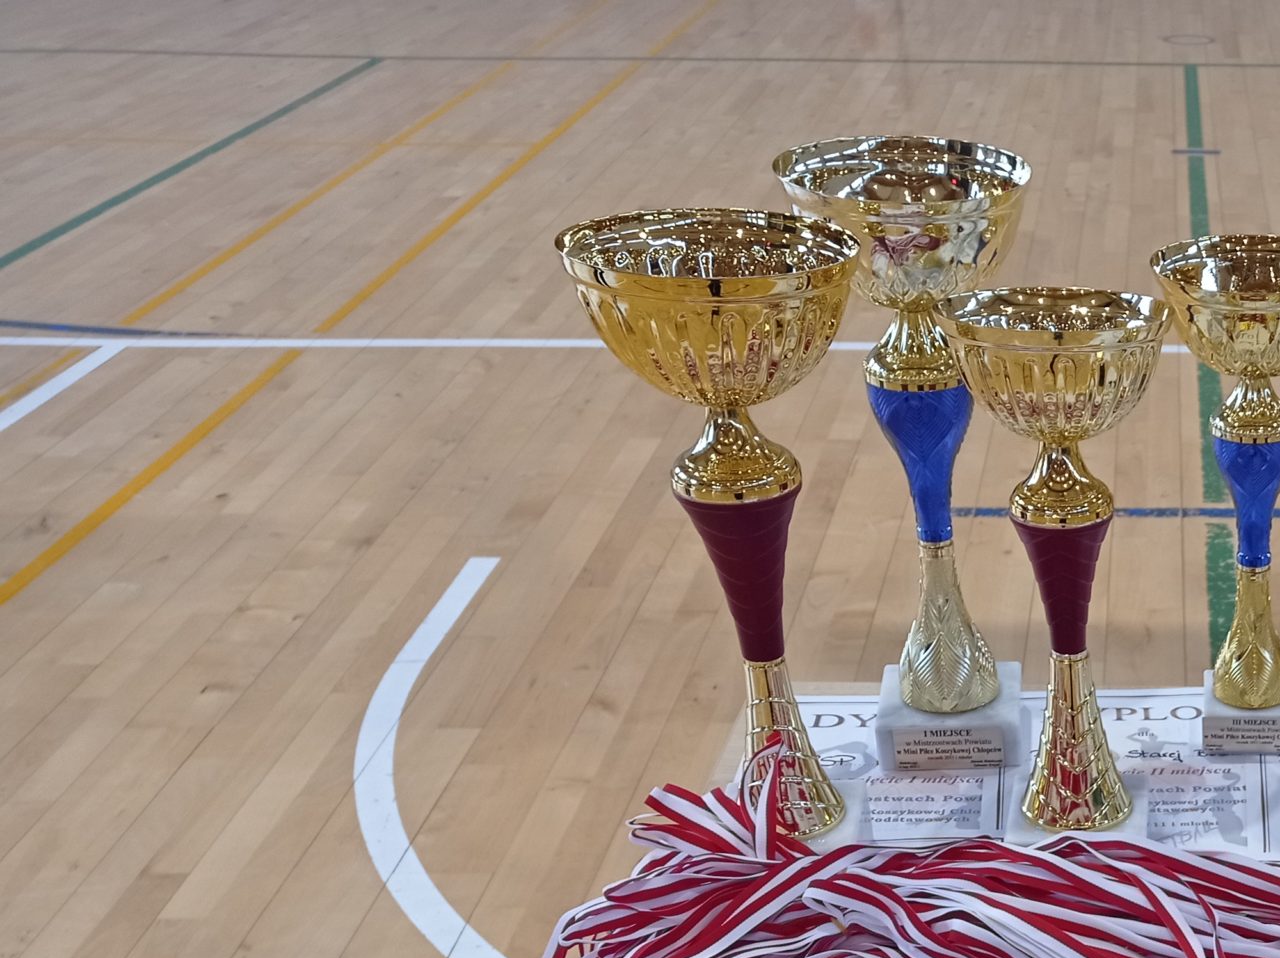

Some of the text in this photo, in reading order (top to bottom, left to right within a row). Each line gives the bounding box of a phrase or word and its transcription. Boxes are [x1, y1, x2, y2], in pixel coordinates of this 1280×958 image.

[923, 729, 973, 738] I MIEJSCE
[1170, 767, 1232, 777] miejsca
[921, 776, 984, 785] miejsca
[1192, 785, 1247, 793] Powiat
[942, 794, 982, 802] Powi
